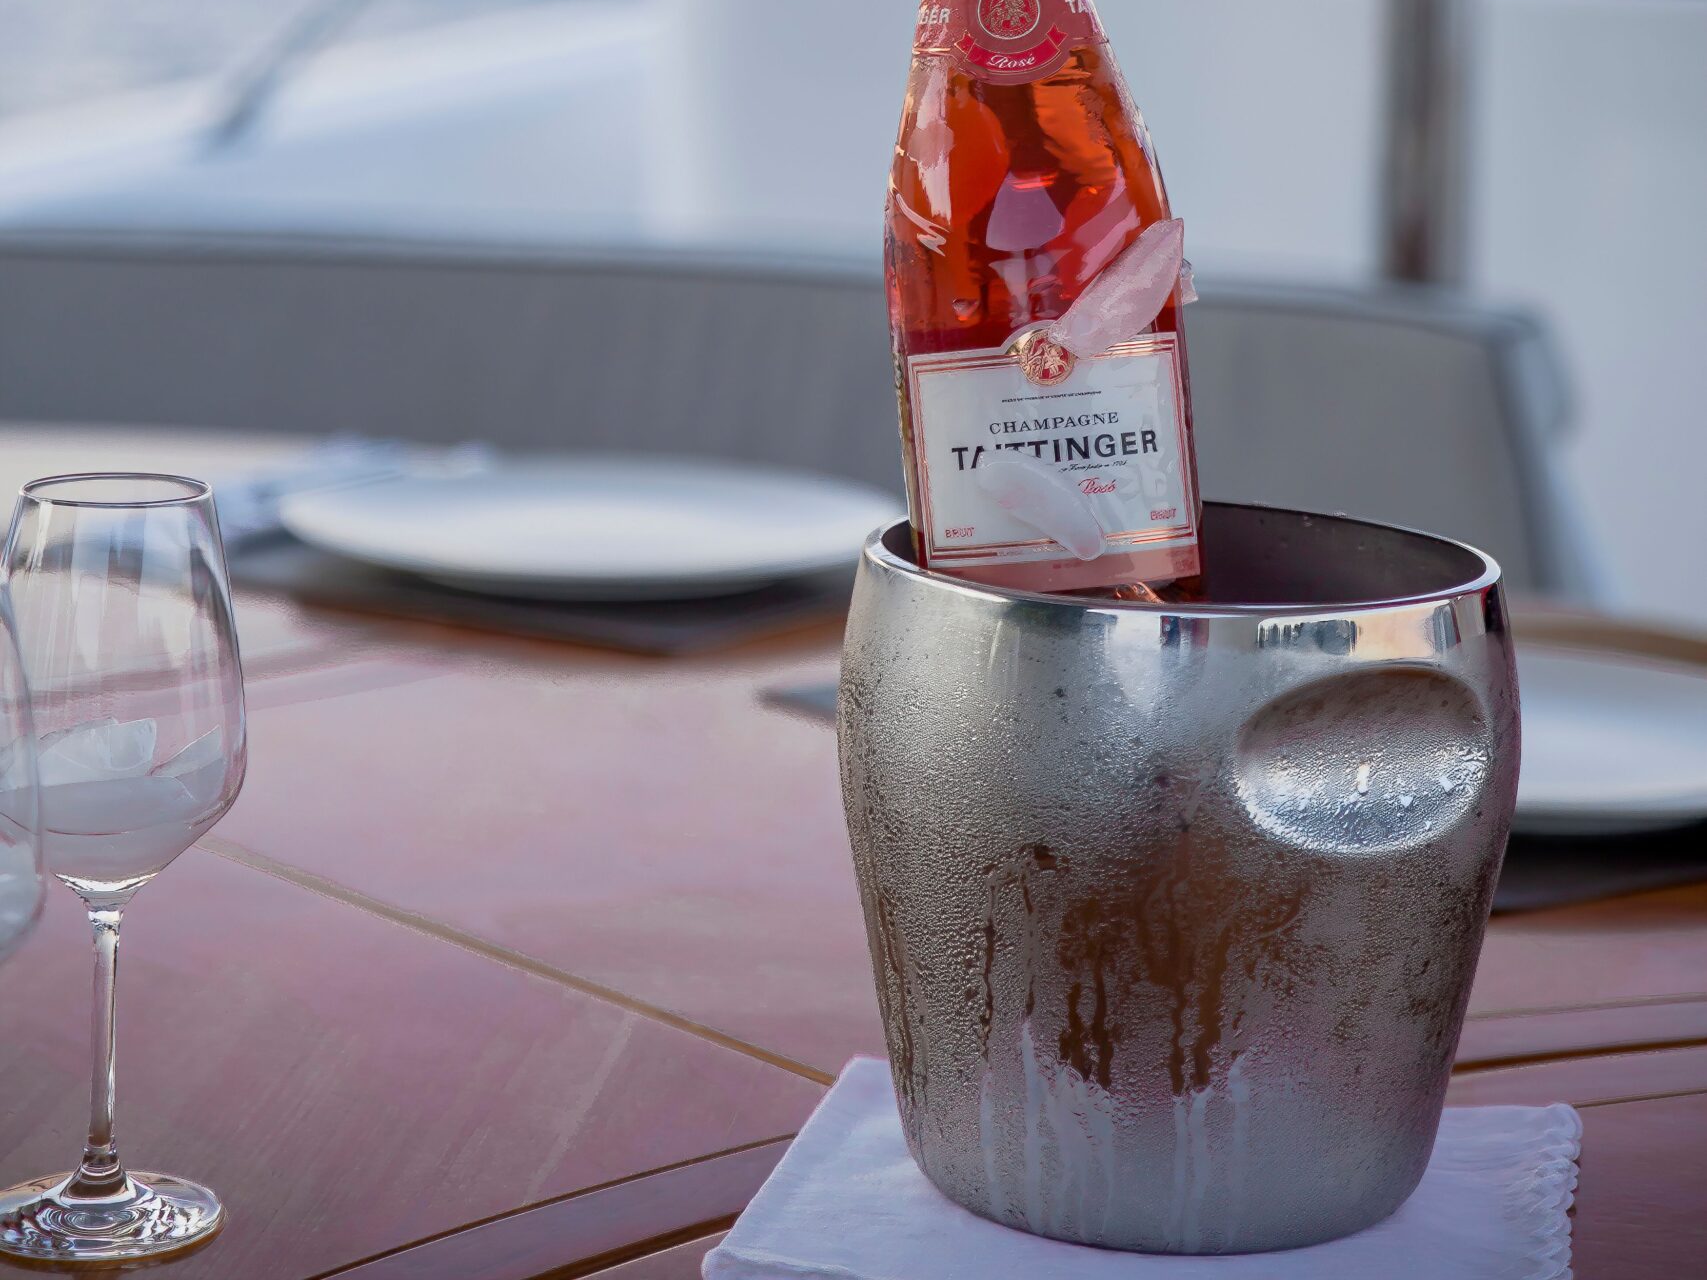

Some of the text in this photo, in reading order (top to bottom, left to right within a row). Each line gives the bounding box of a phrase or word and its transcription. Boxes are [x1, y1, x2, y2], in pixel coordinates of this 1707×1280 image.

[986, 53, 1037, 69] Rosé
[989, 411, 1119, 435] CHAMPAGNE
[951, 429, 1159, 471] TATTINGER
[945, 526, 975, 538] BRUT
